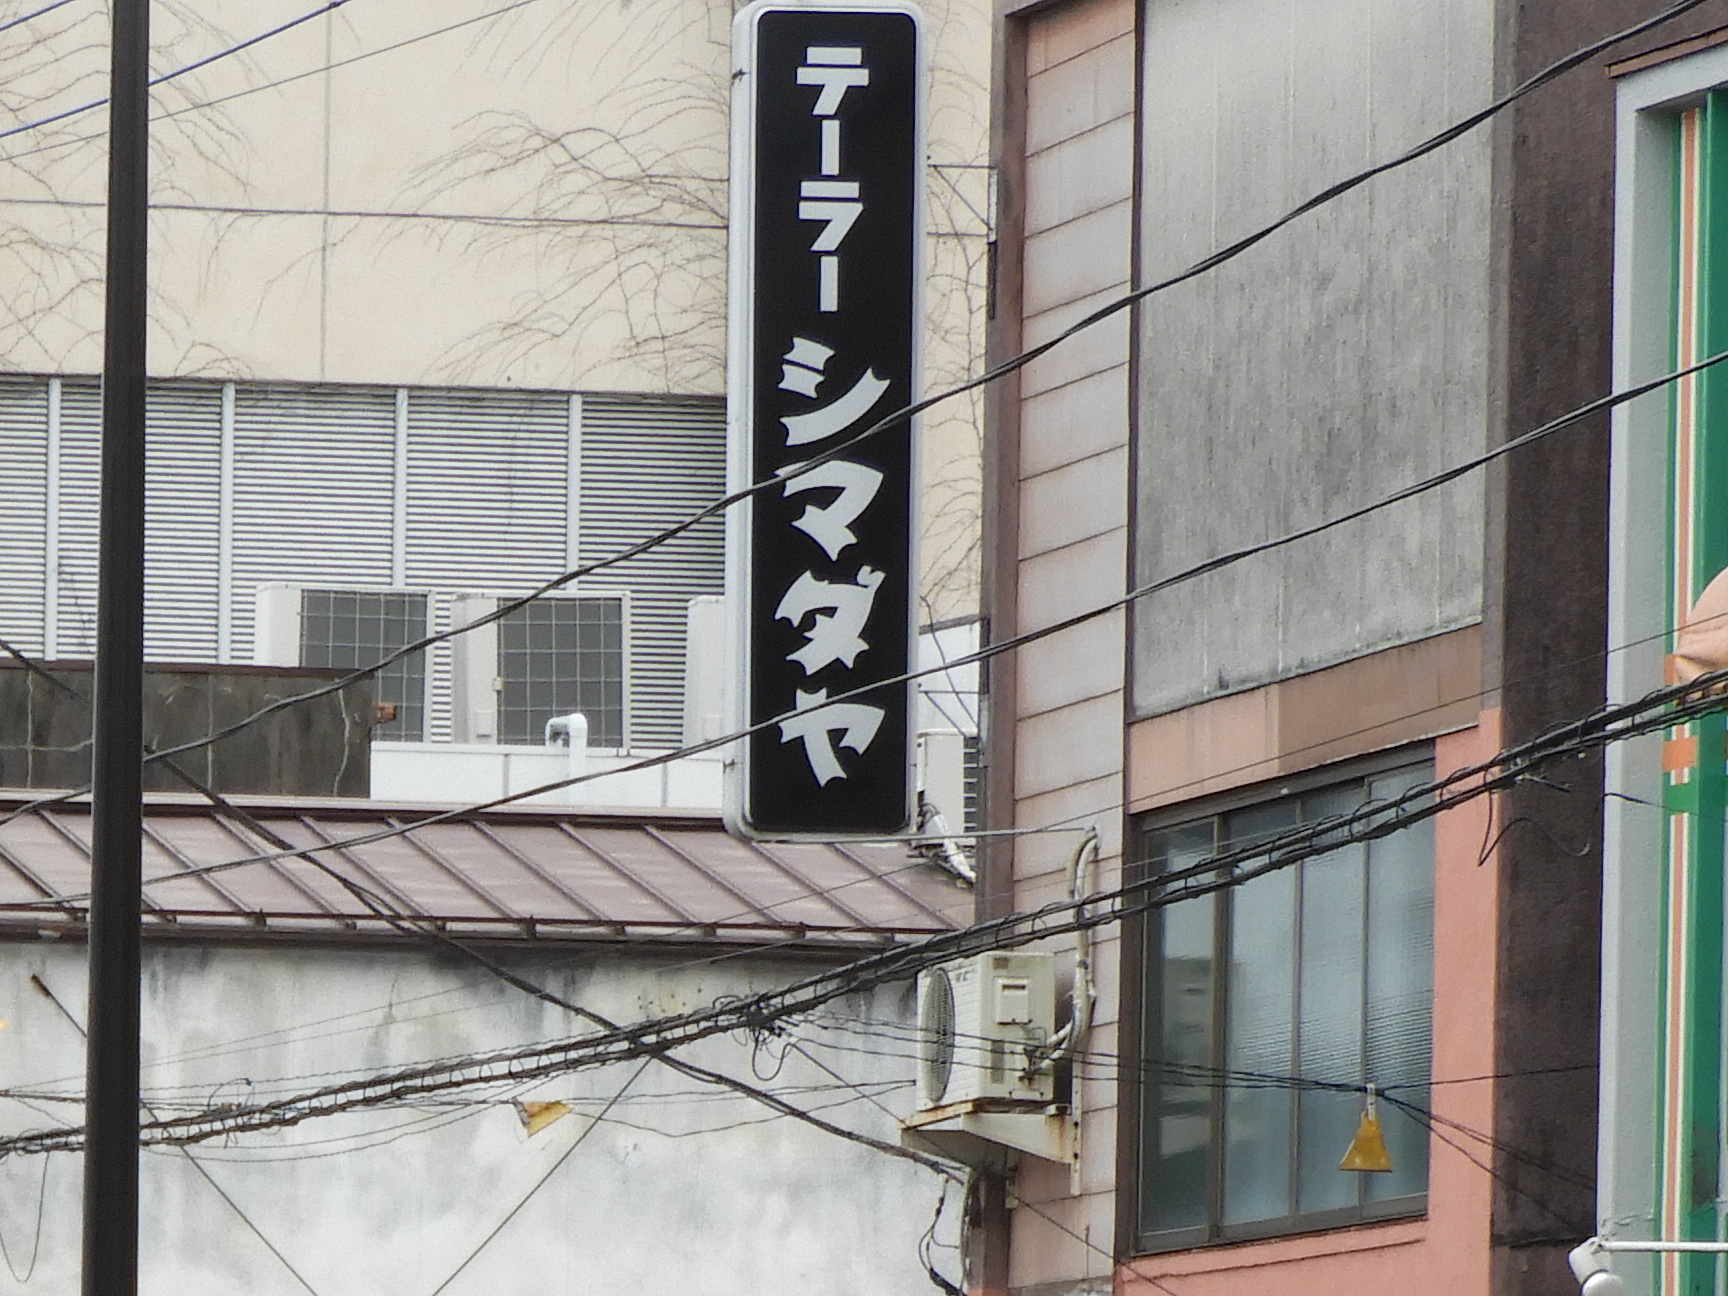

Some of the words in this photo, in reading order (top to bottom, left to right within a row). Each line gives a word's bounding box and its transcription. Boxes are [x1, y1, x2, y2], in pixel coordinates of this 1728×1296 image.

[773, 46, 891, 788] テーラーシマダヤ
